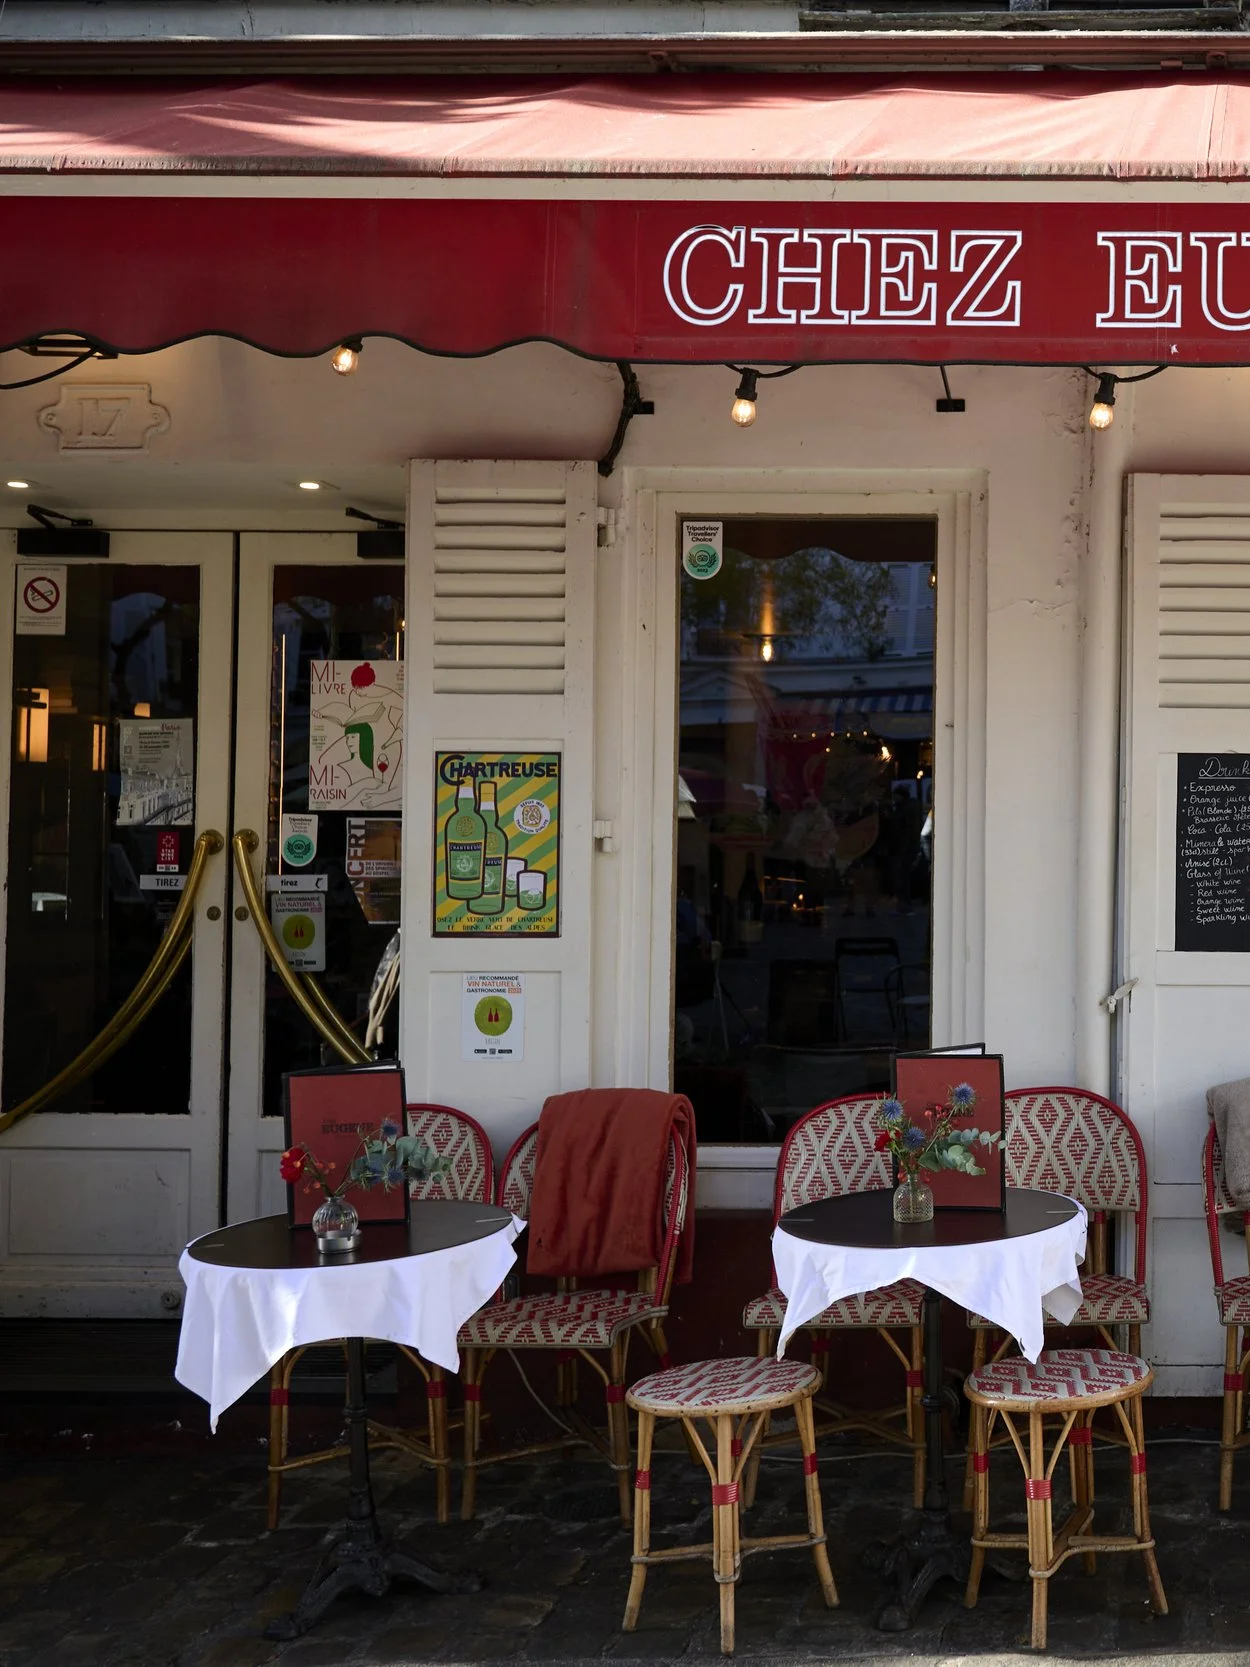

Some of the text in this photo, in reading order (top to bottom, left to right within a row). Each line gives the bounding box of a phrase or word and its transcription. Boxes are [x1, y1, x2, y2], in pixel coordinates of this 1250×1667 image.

[663, 224, 1022, 326] CHEZ
[77, 397, 130, 437] 17
[311, 683, 346, 695] LIVRE
[310, 764, 340, 786] MI-
[1189, 781, 1237, 794] Expresso
[310, 788, 347, 800] RAISIN
[1186, 868, 1212, 879] Glass
[155, 878, 179, 888] TIREZ
[280, 879, 298, 887] tirez
[1197, 888, 1213, 897] Red
